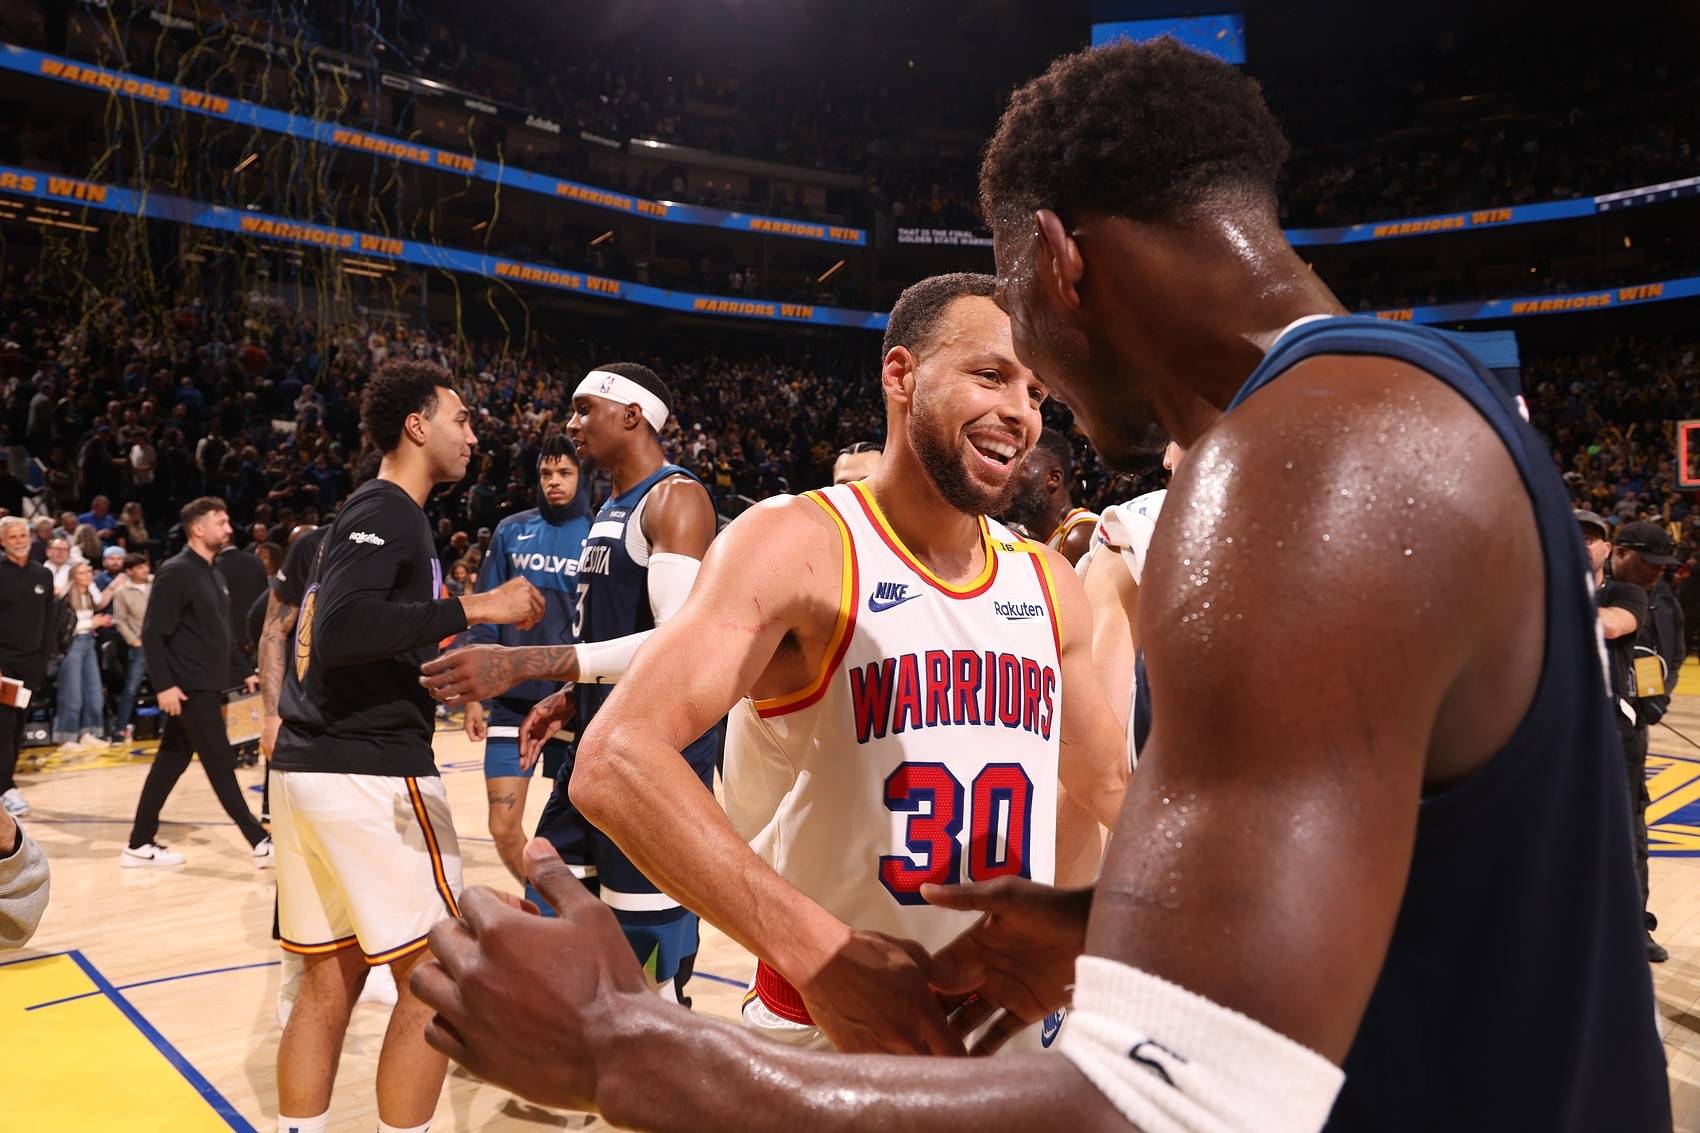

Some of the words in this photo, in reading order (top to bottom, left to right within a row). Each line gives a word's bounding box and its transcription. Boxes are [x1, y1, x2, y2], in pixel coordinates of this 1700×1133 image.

[40, 59, 169, 101] WARRIORS
[179, 88, 228, 113] WIN
[333, 131, 429, 163] WARRIORS
[437, 150, 474, 172] WIN
[48, 176, 106, 203] WIN
[556, 184, 631, 210] WARRIORS
[637, 199, 667, 217] WIN
[240, 217, 353, 249] WARRIORS
[359, 234, 403, 256] WIN
[750, 219, 824, 238] WARRIORS
[829, 226, 860, 241] WIN
[1374, 215, 1465, 238] WARRIORS
[1471, 208, 1513, 225] WIN
[494, 262, 580, 289] WARRIORS
[586, 275, 620, 294] WIN
[693, 298, 775, 317] WARRIORS
[781, 303, 814, 319] WIN
[1511, 293, 1612, 315] WARRIORS
[1618, 283, 1664, 302] WIN
[1376, 309, 1413, 321] WIN
[1000, 542, 1015, 552] 16
[875, 581, 909, 602] NIKE
[994, 601, 1045, 618] Rakuten
[849, 649, 1056, 744] WARRIORS
[878, 761, 1034, 905] 30
